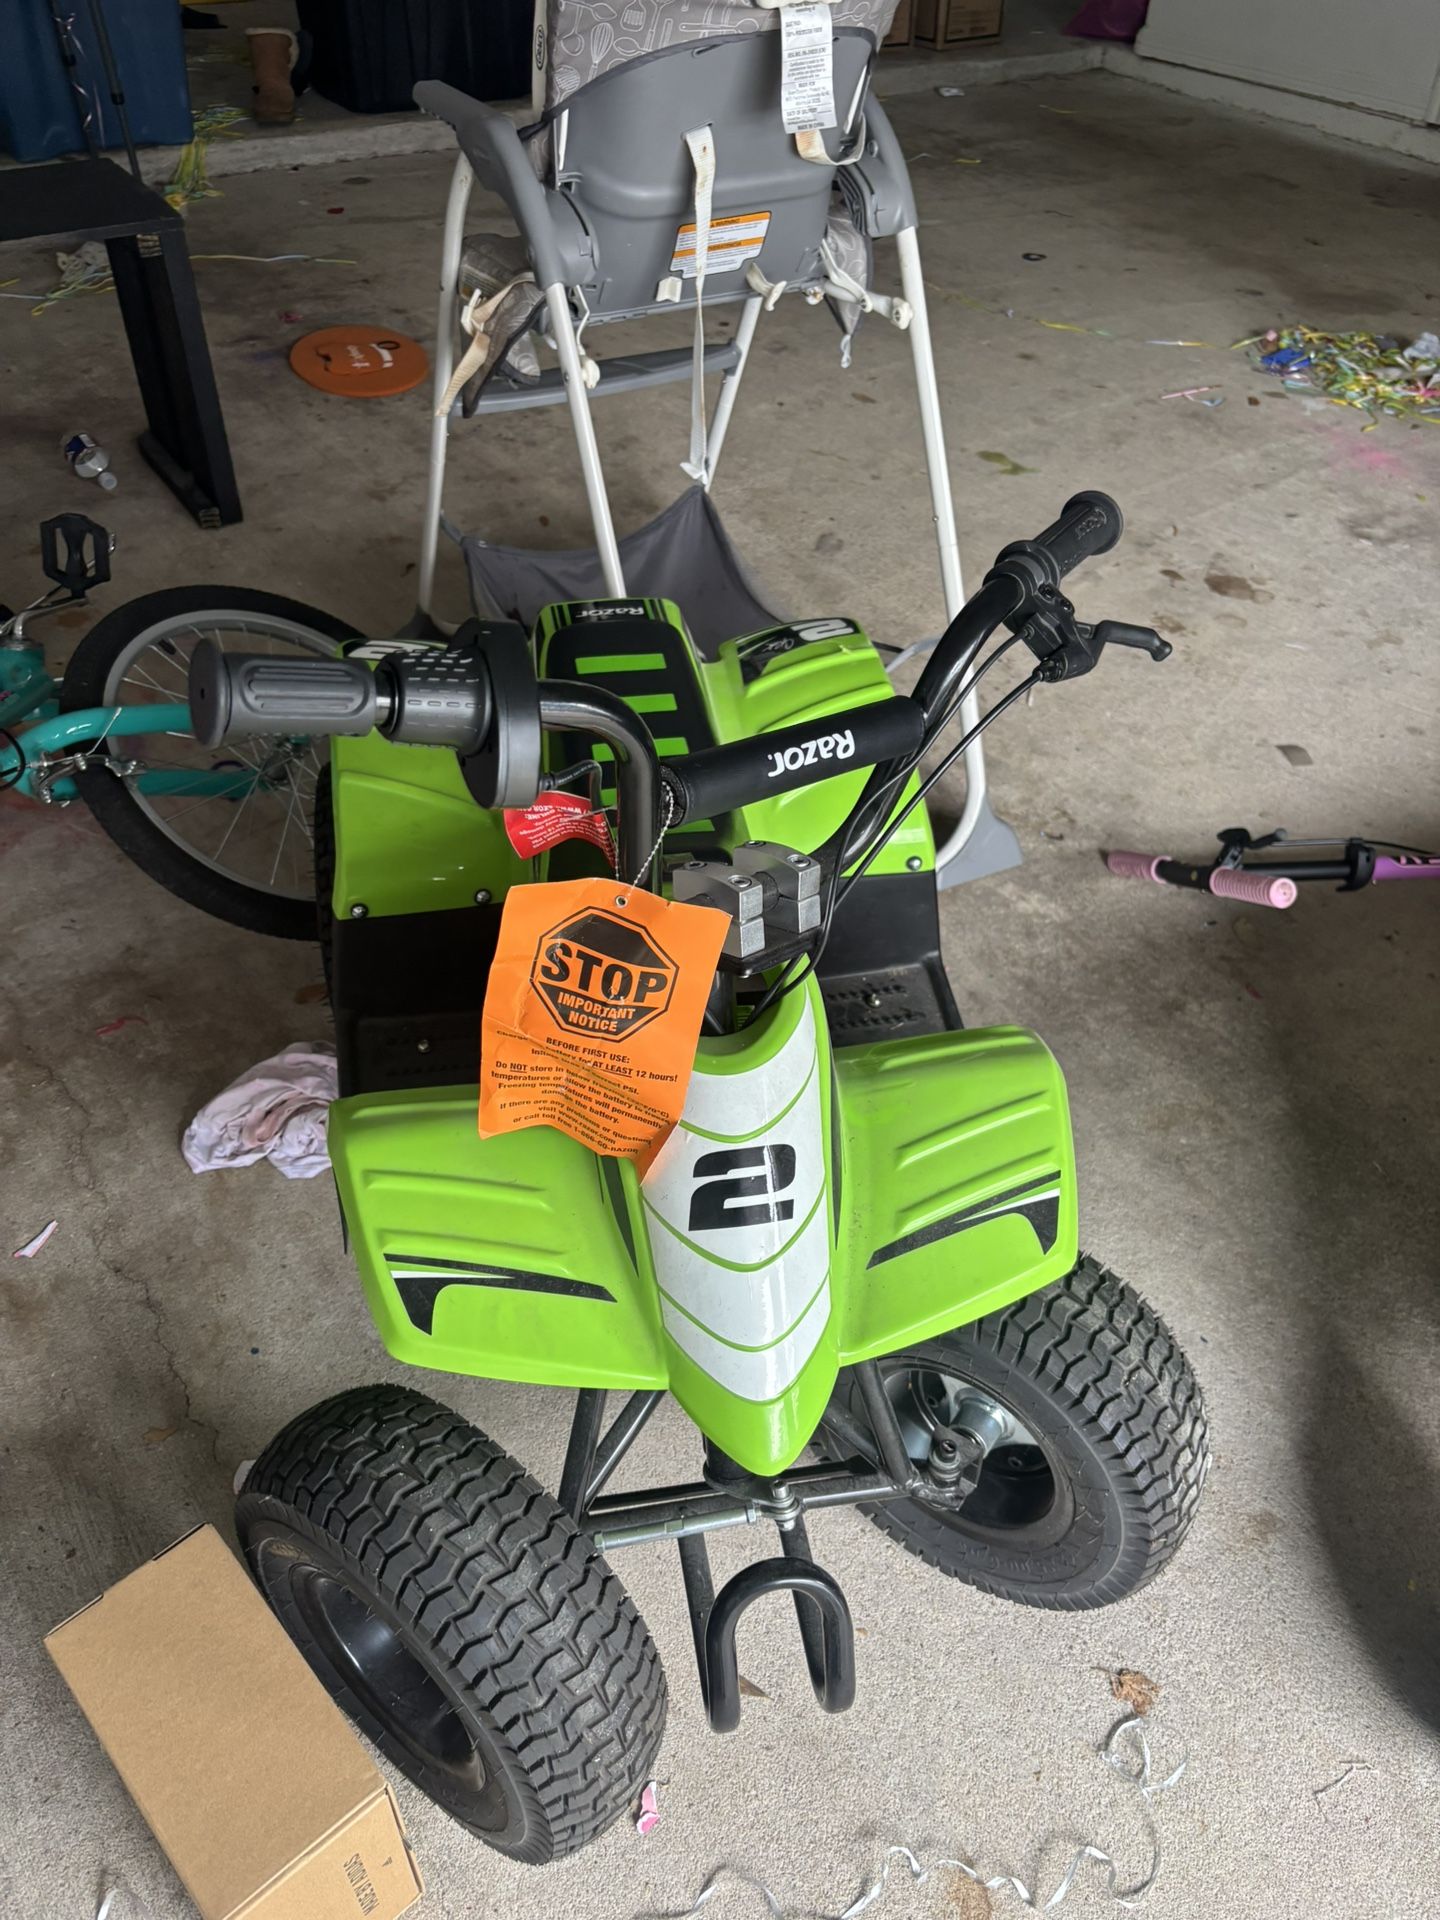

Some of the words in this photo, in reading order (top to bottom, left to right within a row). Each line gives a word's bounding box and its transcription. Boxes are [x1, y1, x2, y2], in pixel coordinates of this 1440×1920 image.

[540, 942, 668, 1003] STOP
[557, 991, 636, 1020] IMPORTANT
[568, 1011, 618, 1032] NOTICE
[546, 1037, 580, 1053] BEFORE
[582, 1047, 608, 1059] FIRST
[609, 1053, 630, 1064] USE:
[495, 1060, 507, 1069] Do
[509, 1061, 528, 1072] NOT
[530, 1064, 553, 1073] store
[555, 1065, 564, 1073] in
[591, 1061, 603, 1069] AT
[605, 1063, 633, 1076] LEAST
[636, 1070, 647, 1078] 12
[648, 1072, 678, 1083] hours!
[491, 1070, 551, 1082] temperatures
[565, 1076, 586, 1089] allow
[588, 1085, 602, 1095] the
[603, 1091, 633, 1109] battery
[498, 1082, 537, 1090] Freezing
[539, 1082, 593, 1102] temperatures
[594, 1098, 610, 1110] will
[611, 1106, 663, 1129] permanently
[508, 1100, 532, 1108] there
[550, 1099, 565, 1108] any
[575, 1099, 588, 1109] the
[589, 1106, 620, 1124] battery.
[557, 1116, 573, 1128] free
[688, 1144, 796, 1231] 2
